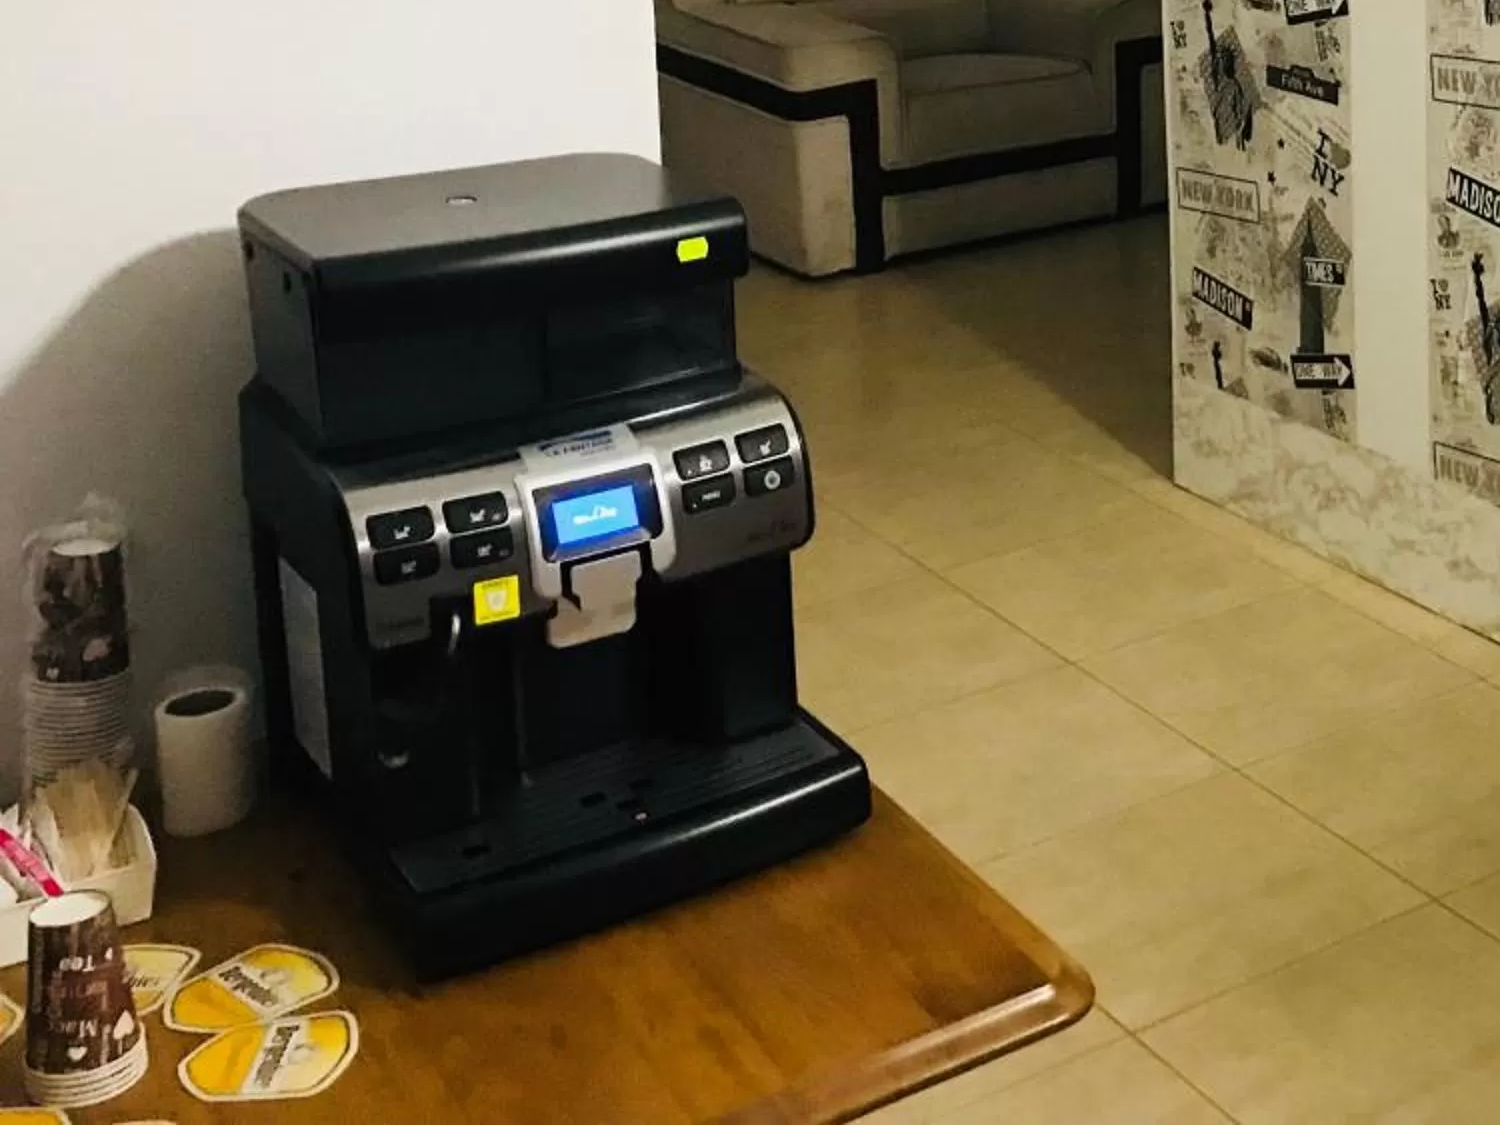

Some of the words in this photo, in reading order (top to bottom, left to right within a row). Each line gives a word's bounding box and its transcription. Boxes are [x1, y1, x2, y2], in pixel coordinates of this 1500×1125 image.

[1437, 67, 1477, 95] NEW
[1315, 128, 1330, 159] I
[1311, 155, 1345, 196] NY
[1182, 178, 1212, 203] NEW
[1214, 179, 1254, 212] YORK
[1305, 261, 1334, 283] TIMES
[1193, 269, 1245, 323] MADISON
[1439, 456, 1477, 490] NEW
